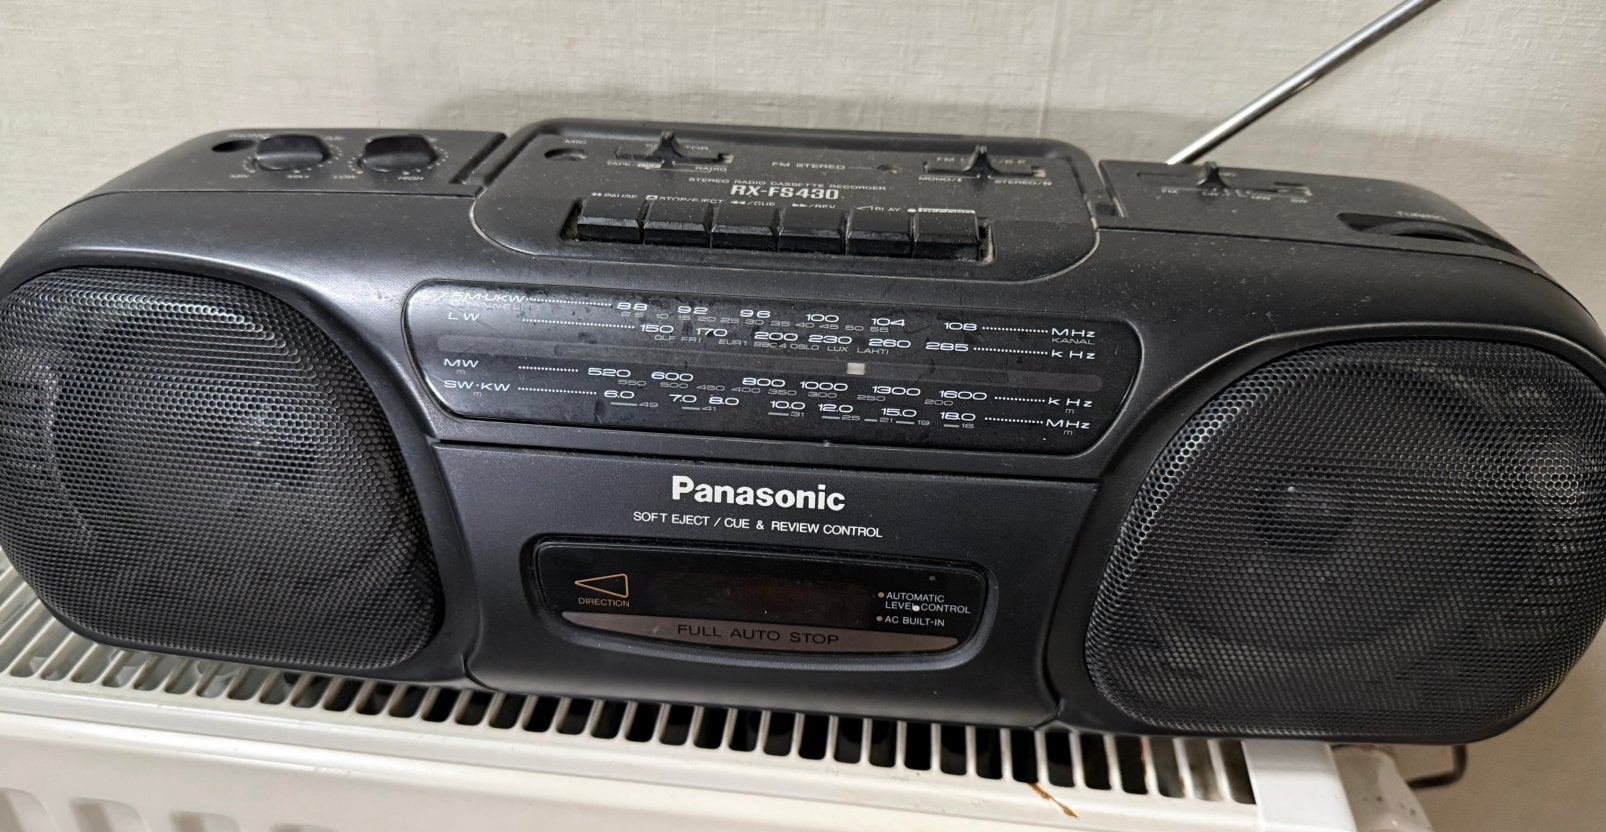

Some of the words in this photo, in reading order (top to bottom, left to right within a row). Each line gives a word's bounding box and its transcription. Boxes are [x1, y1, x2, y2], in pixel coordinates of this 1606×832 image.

[795, 162, 846, 170] STEREO
[730, 184, 840, 200] RX-FS430
[617, 302, 648, 311] 88
[677, 305, 708, 315] 92
[740, 309, 771, 319] 96
[806, 313, 840, 323] 100
[871, 317, 906, 327] 104
[944, 322, 978, 331] 108
[1051, 328, 1096, 338] MHz
[697, 315, 717, 323] 20
[745, 318, 765, 326] 30
[1051, 337, 1096, 346] KANAL
[640, 324, 674, 334] 150
[696, 327, 728, 337] 170
[754, 331, 799, 342] 200
[808, 334, 853, 345] 230
[868, 338, 912, 348] 260
[925, 341, 969, 352] 285
[654, 334, 677, 342] DLF
[790, 343, 820, 351] OSLO
[827, 345, 849, 353] LUX
[857, 347, 890, 355] LAHTI
[443, 358, 480, 369] MW
[587, 367, 631, 378] 520
[651, 371, 694, 382] 600
[742, 377, 786, 388] 800
[800, 381, 849, 392] 1000
[872, 385, 921, 397] 1300
[938, 389, 987, 401] 1600
[618, 379, 647, 387] 550
[660, 381, 689, 389] 500
[696, 384, 726, 392] 450
[731, 386, 761, 394] 400
[767, 388, 798, 396] 350
[807, 391, 838, 399] 300
[857, 394, 886, 402] 250
[924, 398, 954, 407] 200
[604, 389, 635, 399] 6.0
[669, 393, 698, 403] 7.0
[709, 396, 740, 406] 8.0
[770, 400, 806, 410] 10.0
[818, 403, 854, 413] 12.0
[881, 408, 917, 417] 15.0
[940, 411, 976, 421] 18.0
[1046, 419, 1091, 429] MHz
[672, 475, 846, 511] Panasonic
[633, 511, 668, 523] SOFT
[671, 513, 711, 526] EJECT
[713, 517, 722, 527] /
[724, 517, 750, 529] CUE
[756, 520, 765, 530] &
[771, 520, 820, 534] REVIEW
[822, 524, 884, 538] CONTROL
[578, 597, 630, 608] DIRECTION
[886, 591, 945, 603] AUTOMATIC
[920, 602, 971, 614] CONTROL
[884, 615, 899, 624] AC
[902, 616, 945, 628] BUILT-IN
[677, 624, 722, 638] FULL
[729, 627, 781, 642] AUTO
[789, 631, 840, 646] STOP
